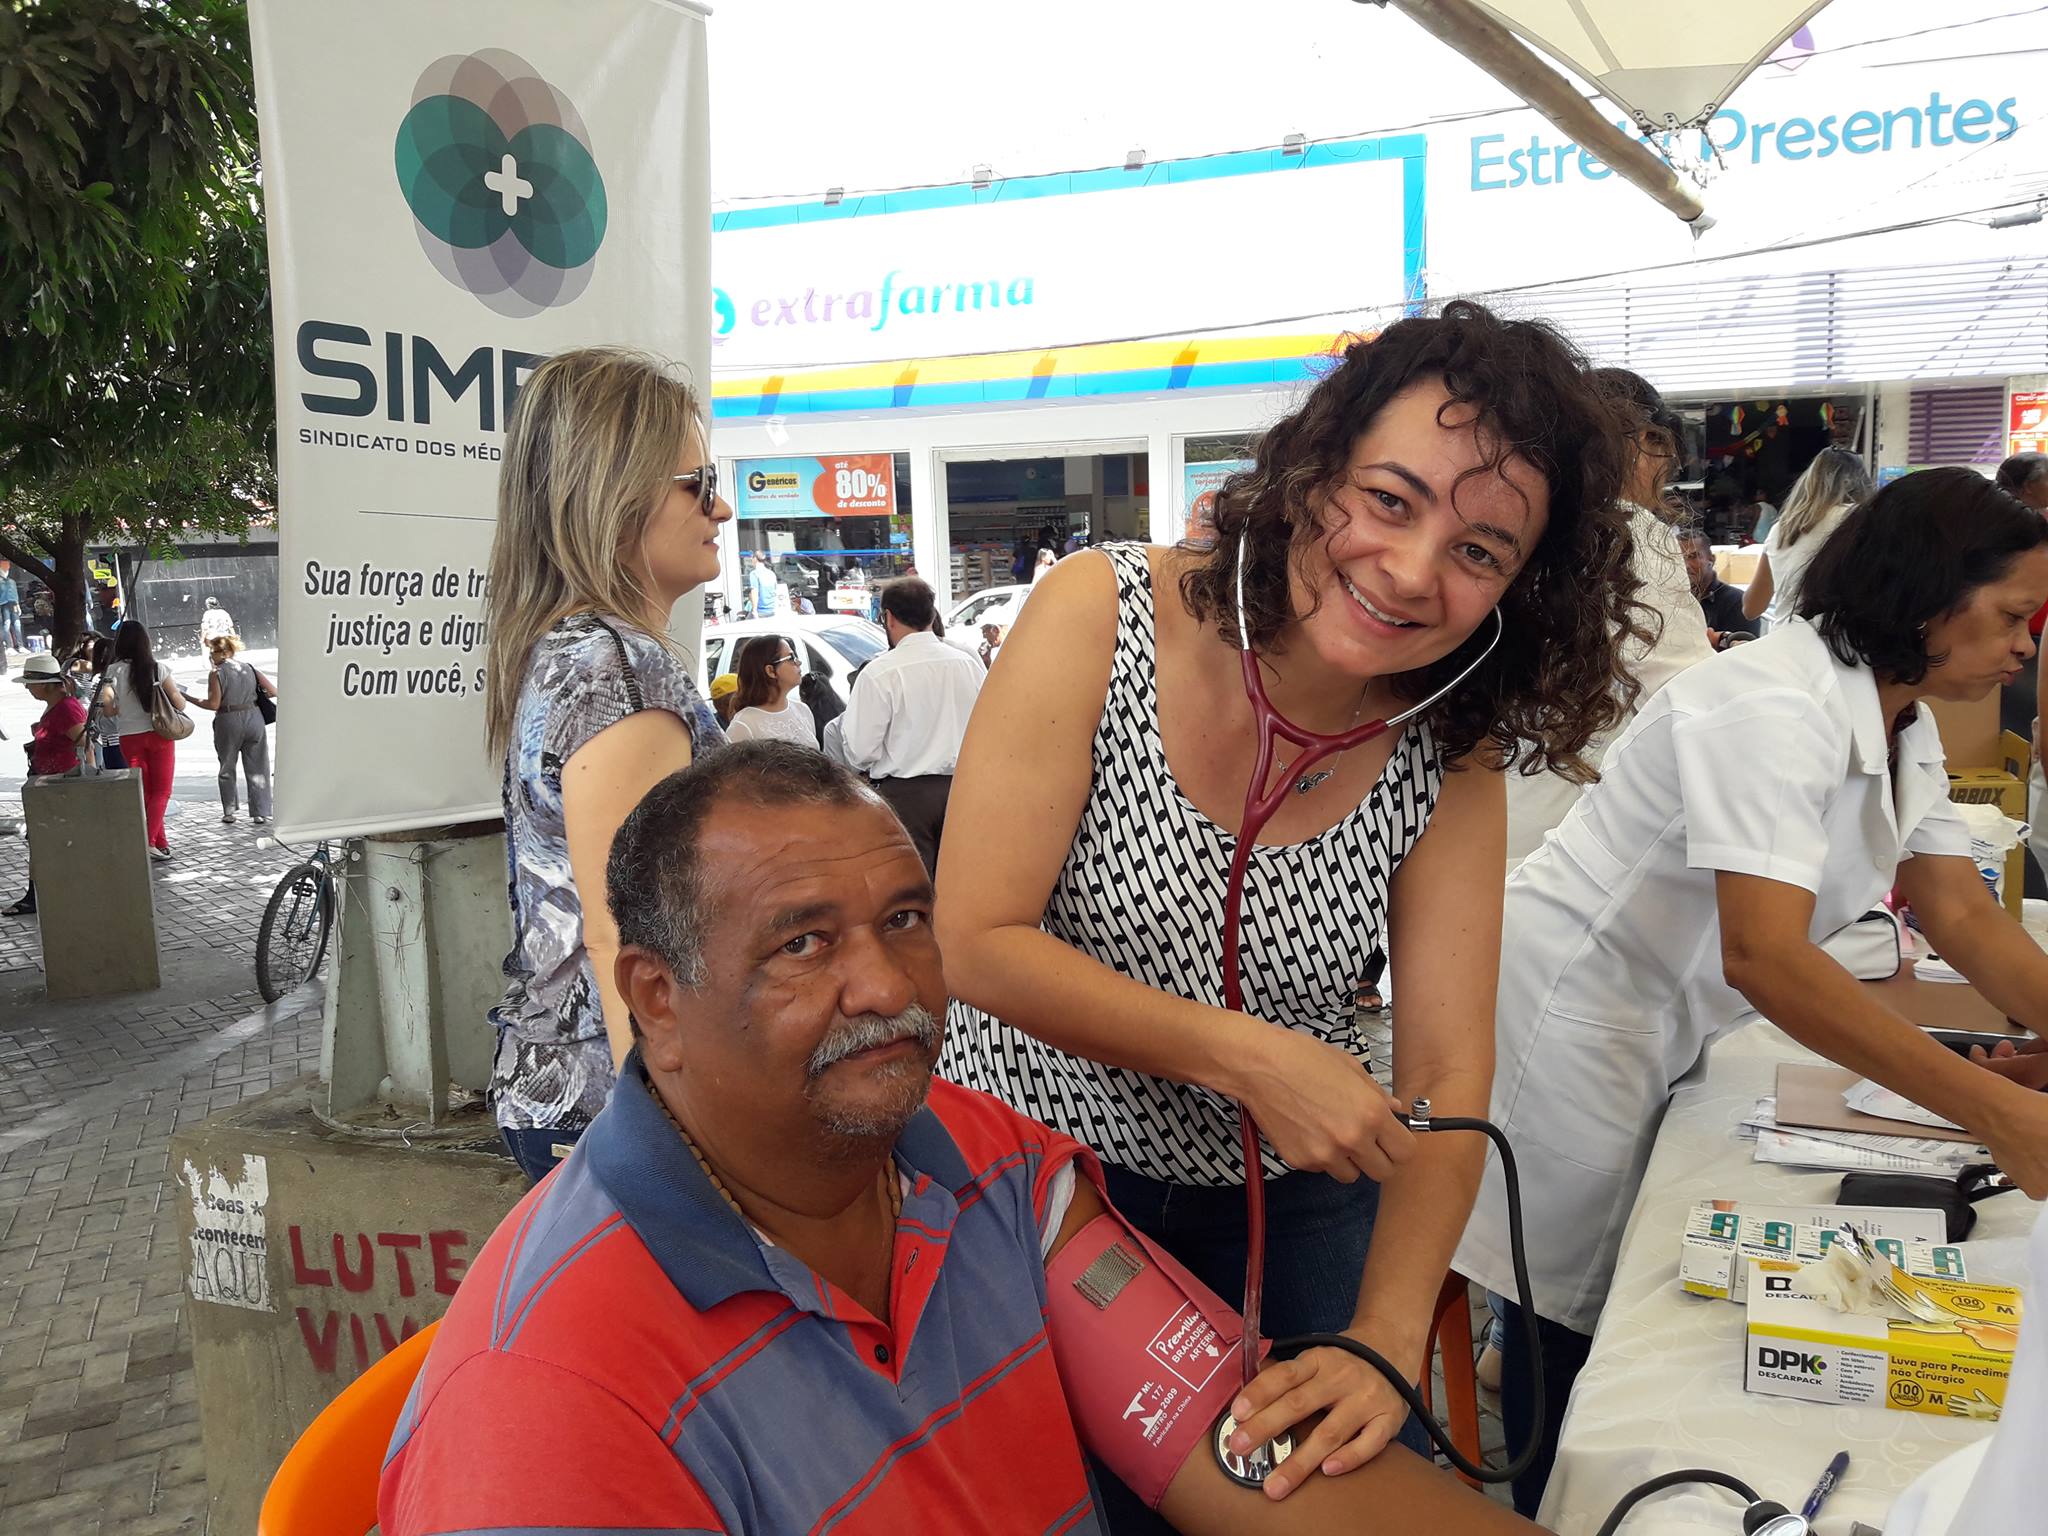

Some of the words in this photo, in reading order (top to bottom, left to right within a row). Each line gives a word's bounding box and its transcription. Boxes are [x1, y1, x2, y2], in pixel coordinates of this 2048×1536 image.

[1700, 91, 2018, 164] Presentes
[750, 269, 1034, 332] extrafarma
[299, 428, 408, 453] SINDICATO
[415, 440, 456, 457] DOS
[834, 461, 849, 469] até
[748, 471, 798, 493] Genéricos
[835, 469, 887, 499] 80%
[836, 500, 848, 508] de
[849, 499, 887, 508] desconto
[304, 560, 352, 596] Sua
[359, 563, 424, 606] força
[432, 566, 460, 598] de
[325, 613, 412, 656] justiça
[419, 619, 434, 646] e
[343, 662, 398, 697] Com
[406, 662, 467, 698] você,
[288, 1225, 469, 1298] LUTE
[1957, 1297, 1980, 1307] 100
[1155, 1310, 1202, 1355] Premium
[1758, 1346, 1823, 1376] DPK
[1891, 1355, 1917, 1367] Luva
[1920, 1360, 1948, 1371] para
[1140, 1380, 1155, 1395] ML
[1758, 1370, 1823, 1386] DESCARPACK
[1890, 1368, 1912, 1378] não
[1915, 1369, 1966, 1385] Cirúrgico
[1151, 1384, 1164, 1401] 177
[1160, 1387, 1178, 1409] 2009
[1896, 1382, 1920, 1397] 100
[1928, 1392, 1944, 1405] M
[1146, 1412, 1168, 1441] INMETRO
[1152, 1419, 1174, 1448] Fabricado
[1177, 1395, 1192, 1412] China
